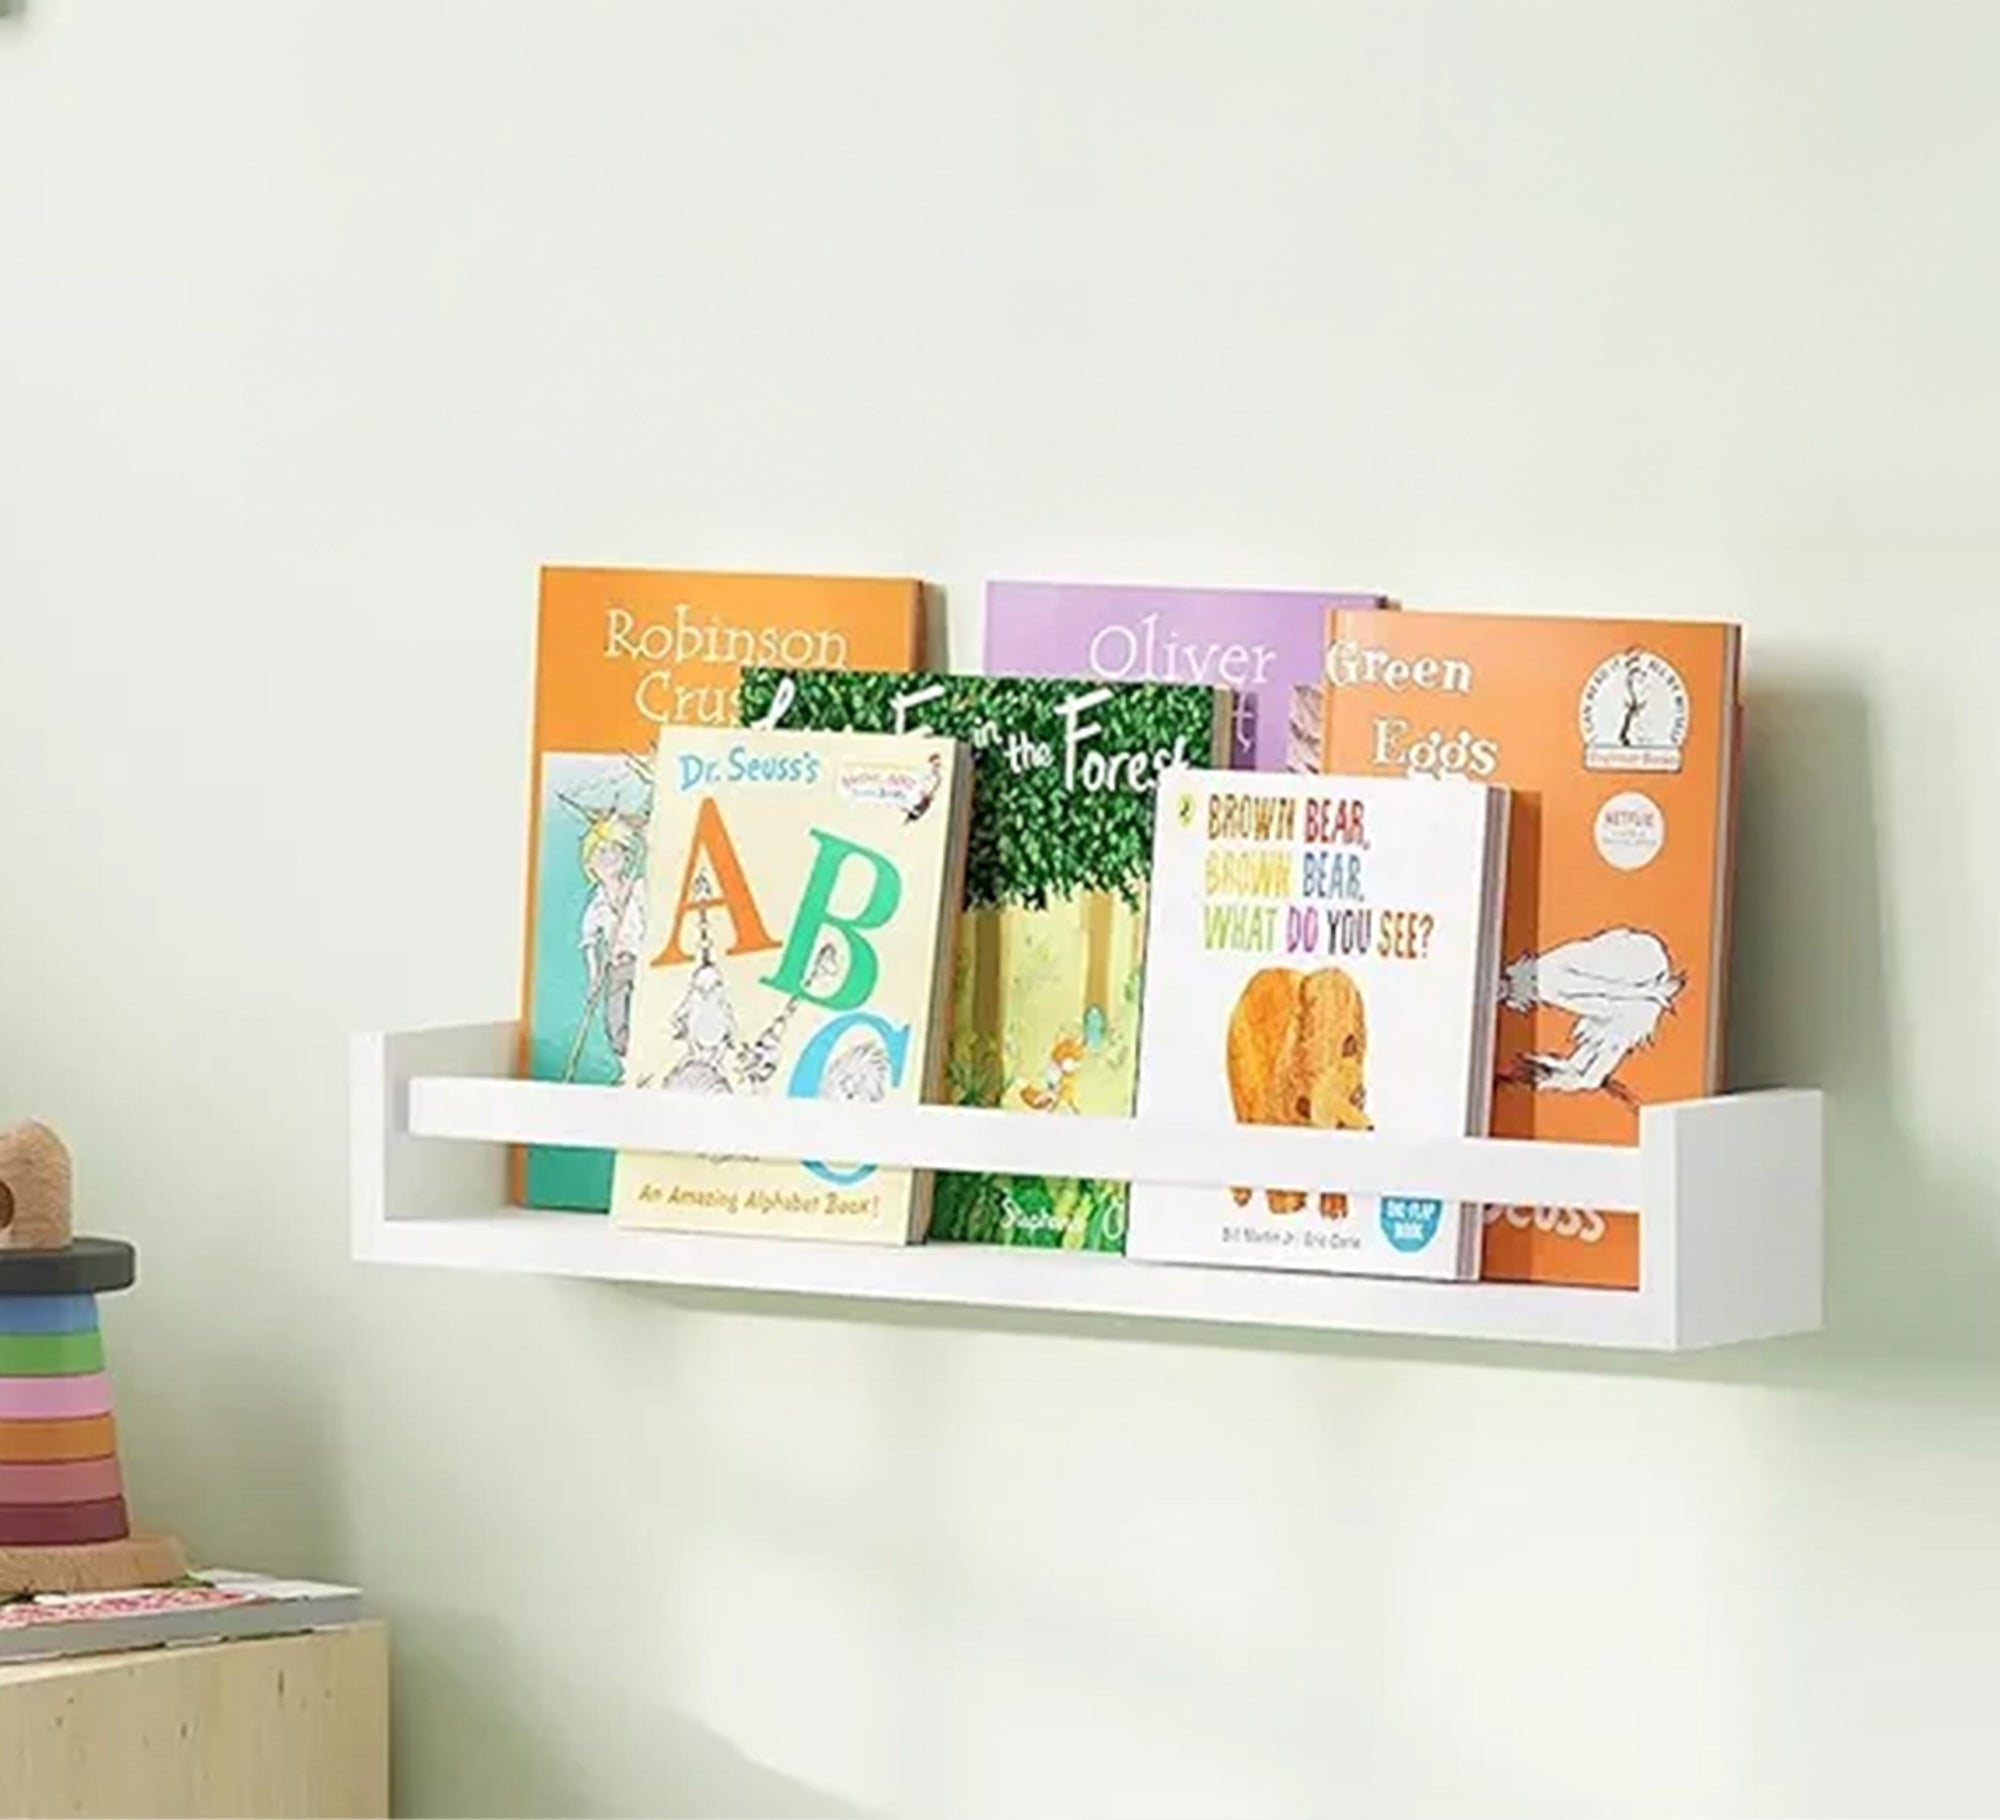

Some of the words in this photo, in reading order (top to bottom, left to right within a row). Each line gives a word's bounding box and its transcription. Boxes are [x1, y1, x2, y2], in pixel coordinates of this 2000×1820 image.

[603, 603, 848, 670] Robinson
[1090, 612, 1277, 684] Oliver
[1325, 639, 1472, 694] Green
[680, 754, 721, 791] Dr.
[727, 745, 820, 784] Seuss's
[973, 715, 1003, 750] in
[1003, 731, 1055, 774] the
[1372, 716, 1500, 778] Eggs
[1207, 794, 1295, 842] BROWN
[1204, 850, 1291, 898] BROWN
[1204, 905, 1278, 950] WHAT
[1285, 907, 1319, 952] DO
[1327, 909, 1372, 955] YOU
[1376, 910, 1435, 959] SEE?
[638, 1184, 662, 1201] An
[666, 1186, 739, 1214] Amazing
[744, 1190, 819, 1214] Alphabet
[824, 1191, 880, 1218] Book!
